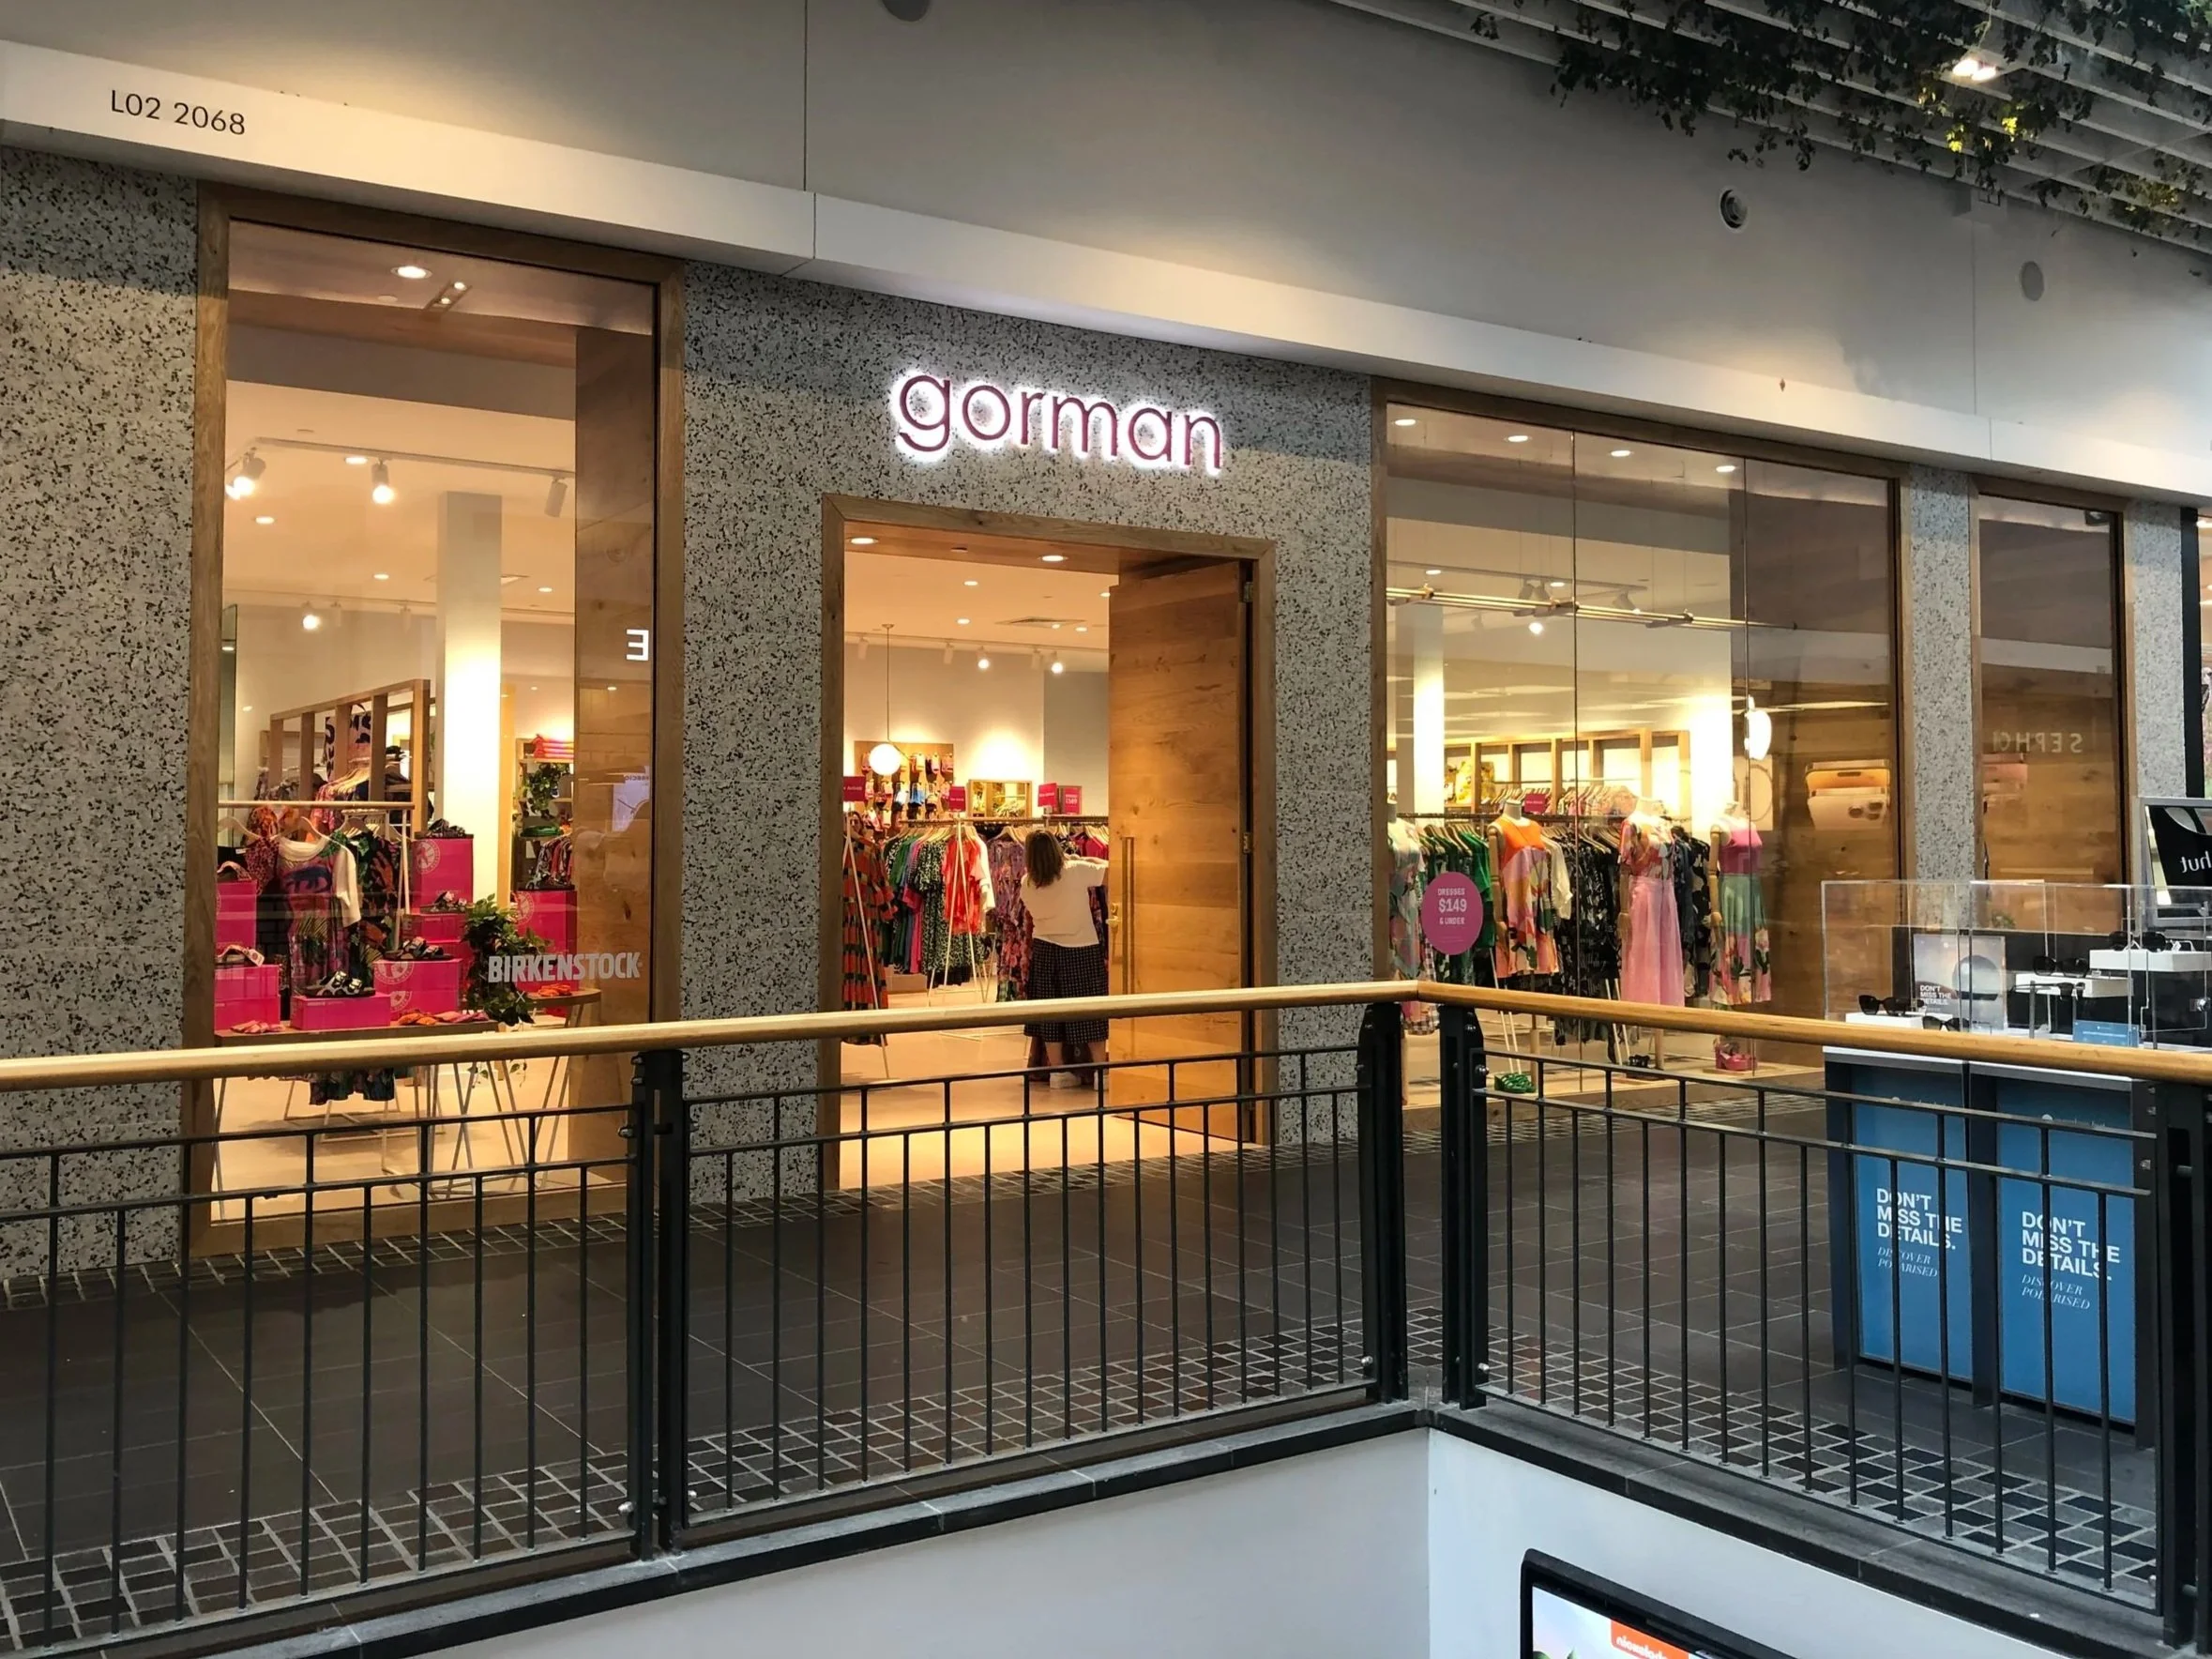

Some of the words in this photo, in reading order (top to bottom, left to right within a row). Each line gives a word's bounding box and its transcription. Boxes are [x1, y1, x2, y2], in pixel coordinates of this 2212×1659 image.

[174, 102, 245, 135] 2068
[898, 373, 1222, 471] gorman
[1437, 888, 1465, 896] DRESSES
[1438, 898, 1467, 913] $149
[488, 951, 641, 983] BIRKENSTOCK
[1877, 1205, 1920, 1226] MSS
[1878, 1246, 1932, 1265] DIOVER
[1878, 1257, 1938, 1277] POARISED
[2022, 1273, 2083, 1296] DISOVER
[2022, 1286, 2090, 1310] POLRISED
